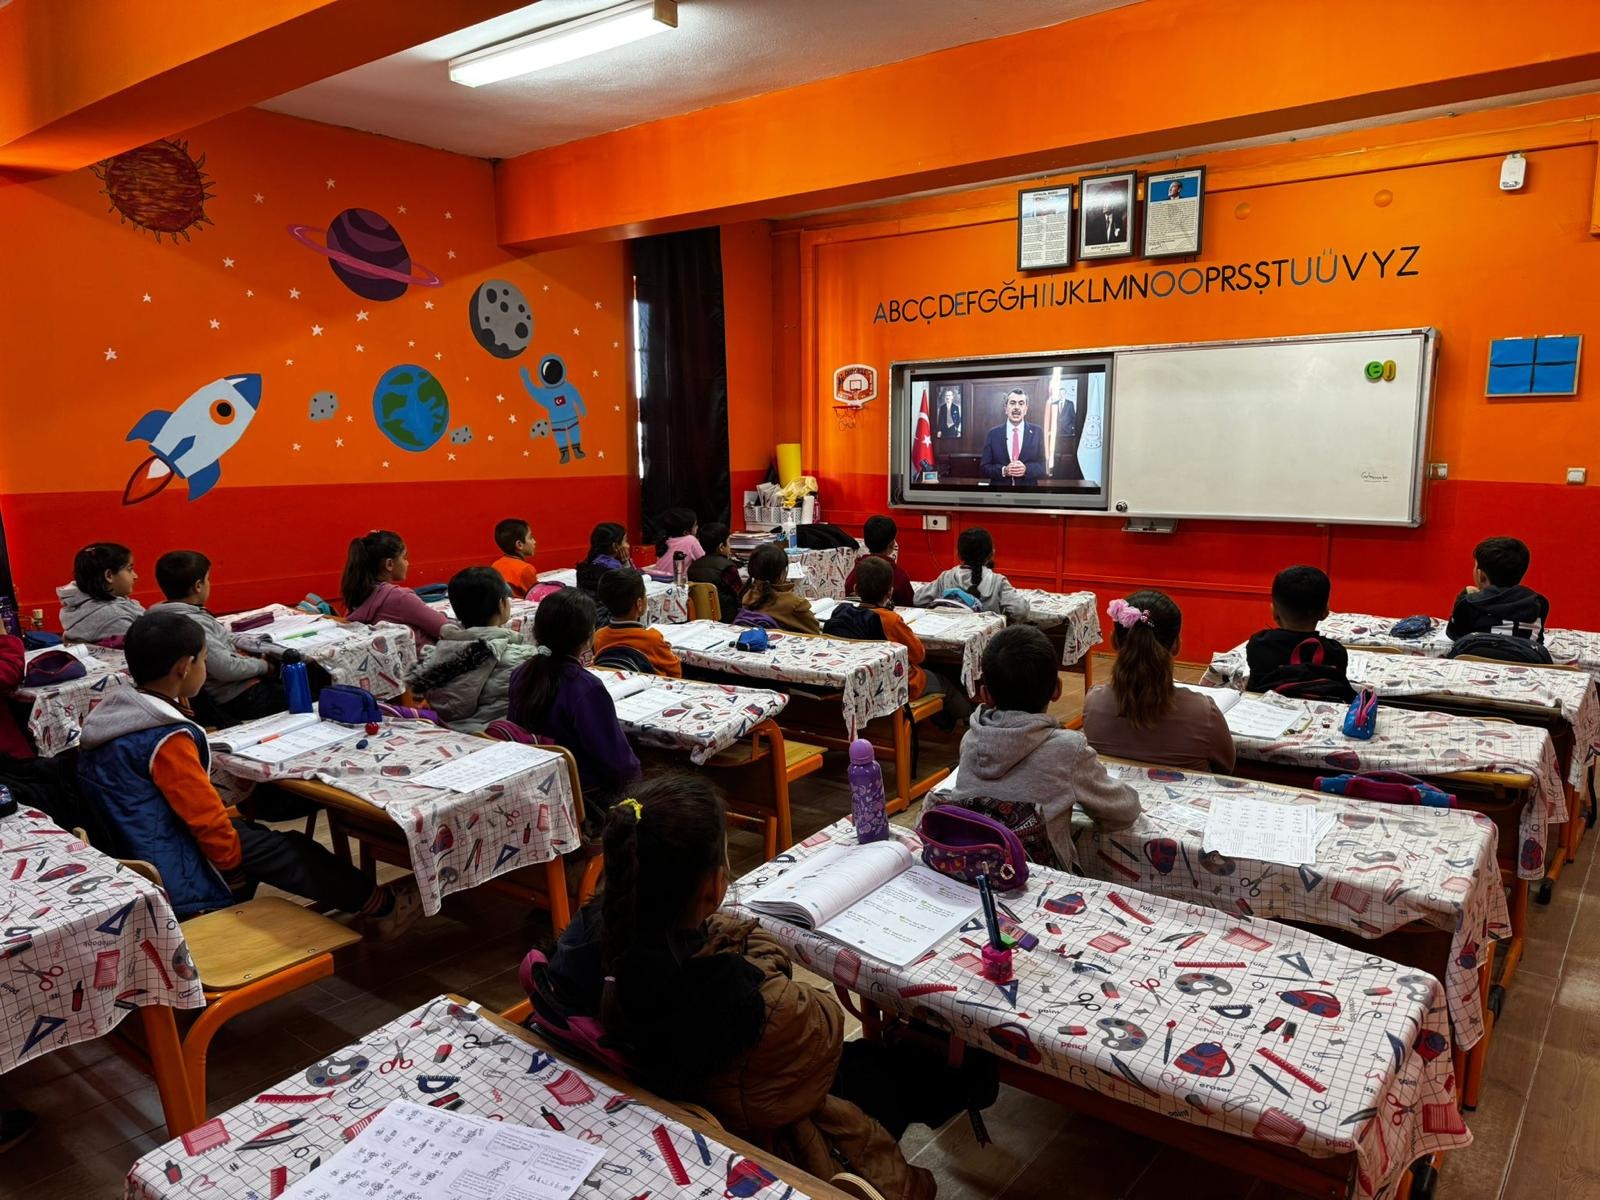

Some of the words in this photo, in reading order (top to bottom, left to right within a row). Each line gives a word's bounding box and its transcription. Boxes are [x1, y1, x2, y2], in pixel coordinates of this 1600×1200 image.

[1139, 904, 1157, 914] ruler
[870, 967, 891, 976] pencil
[1059, 1041, 1089, 1051] pencil
[1302, 1062, 1327, 1073] ruler
[1199, 1082, 1232, 1093] eraser
[1325, 1138, 1356, 1150] pencil
[636, 1147, 655, 1162] ruler
